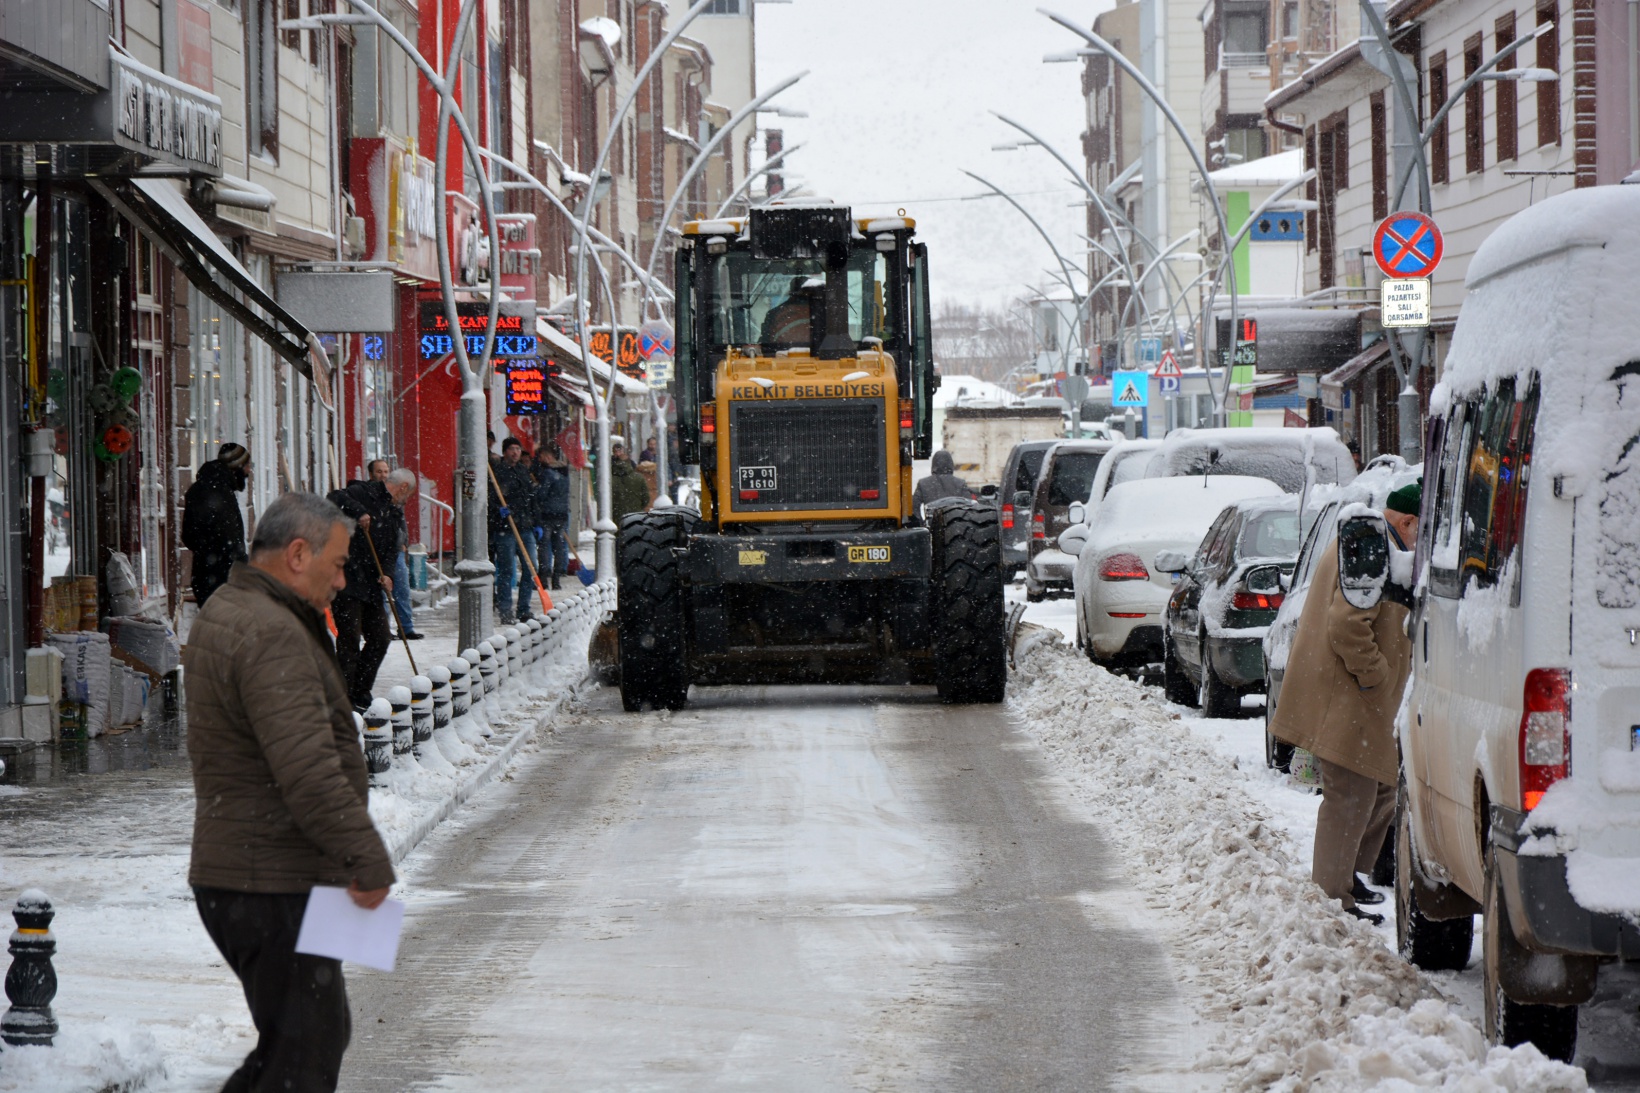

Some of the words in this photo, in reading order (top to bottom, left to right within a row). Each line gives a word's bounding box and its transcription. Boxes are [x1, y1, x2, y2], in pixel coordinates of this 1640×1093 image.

[1387, 292, 1421, 302] PAZARTESİ
[435, 315, 521, 328] LKANASI
[1162, 376, 1178, 391] D
[732, 384, 788, 398] KELKİT
[794, 382, 885, 398] BELEDİYESİ
[742, 469, 755, 478] 29
[761, 469, 773, 478] 01
[749, 480, 774, 489] 1610
[850, 549, 864, 560] GR
[867, 548, 887, 560] 180
